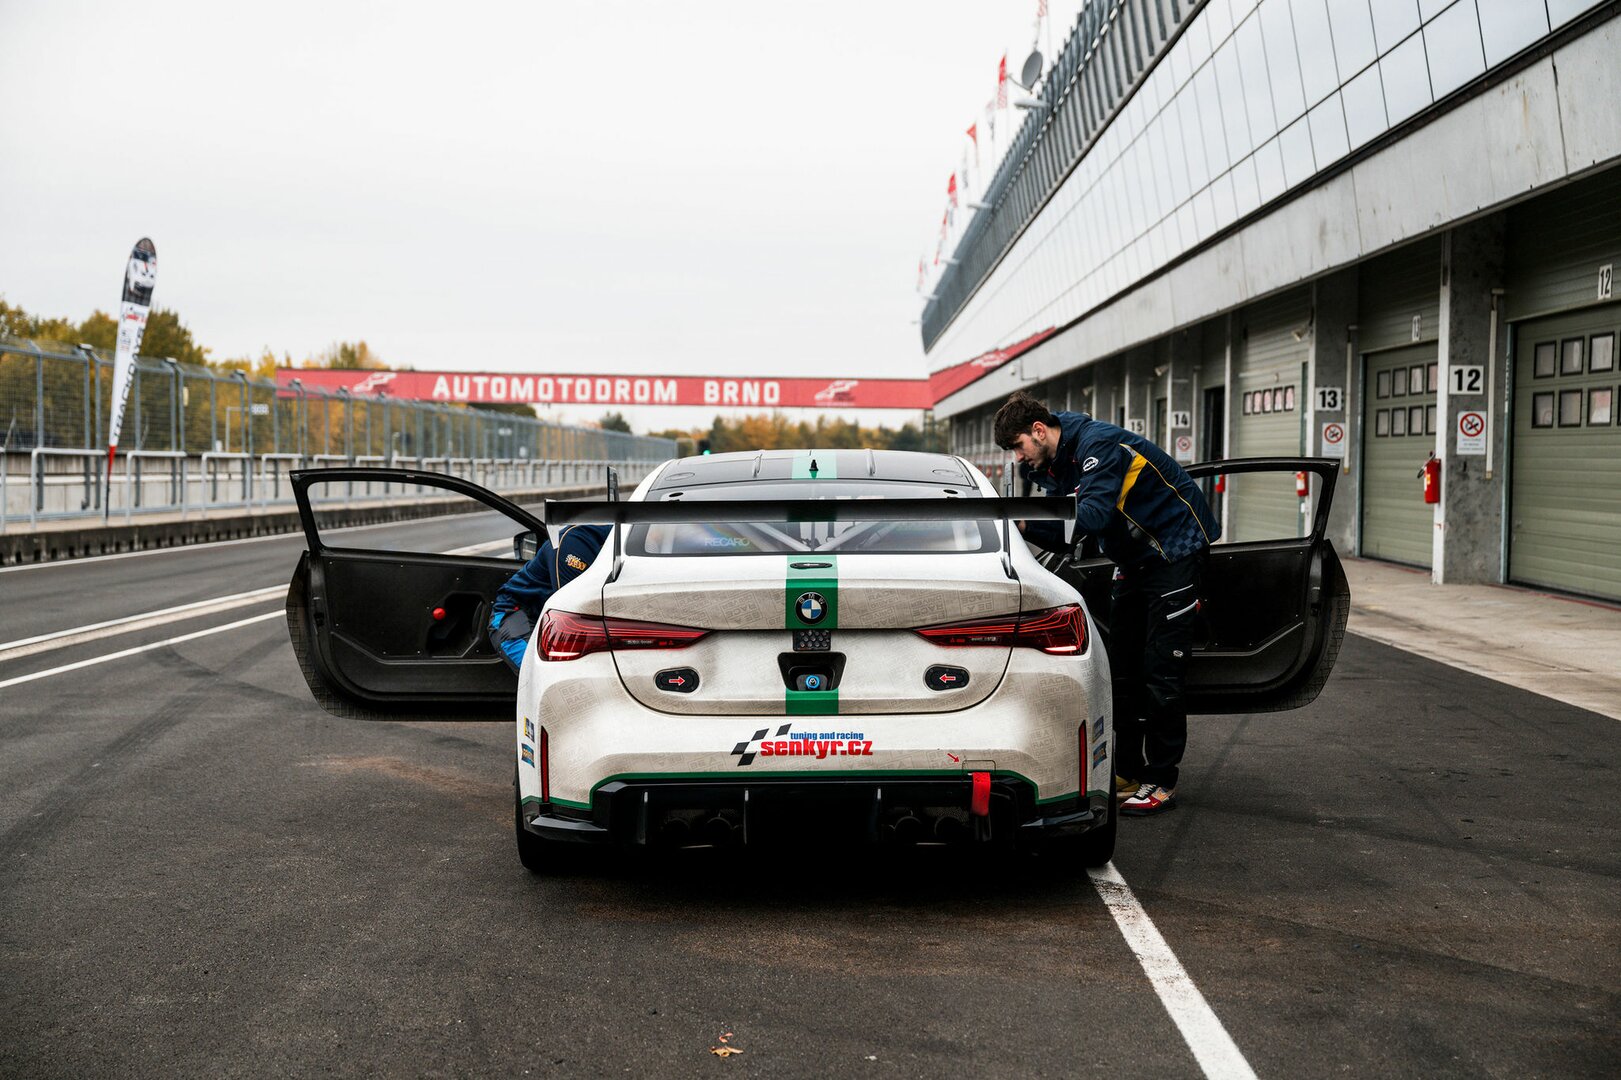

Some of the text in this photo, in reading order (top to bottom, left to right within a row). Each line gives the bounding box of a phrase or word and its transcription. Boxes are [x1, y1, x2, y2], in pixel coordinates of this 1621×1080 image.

[1600, 268, 1611, 296] 12
[1454, 368, 1481, 392] 12
[432, 375, 781, 405] AUTOMOTODROM BRNO
[1319, 390, 1338, 408] 13
[1131, 421, 1143, 432] 15
[1174, 414, 1188, 426] 14
[704, 537, 750, 547] RECARO
[798, 593, 825, 605] BMW
[790, 732, 864, 741] tuning and racing
[760, 738, 873, 759] senkyr.cz
